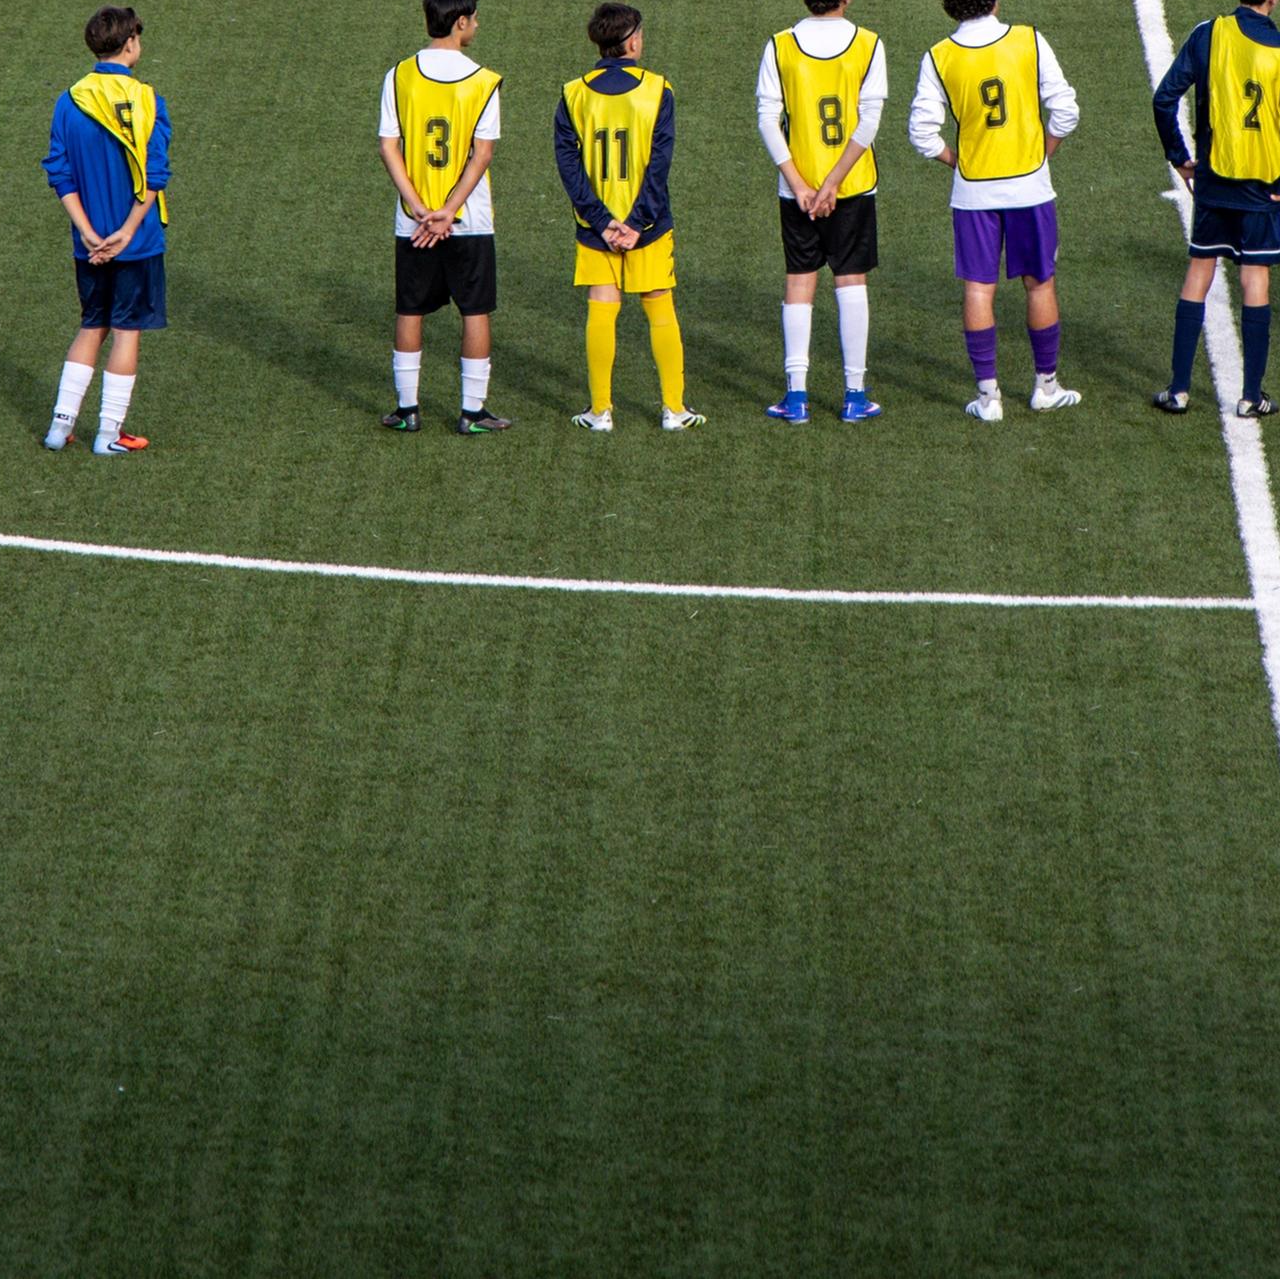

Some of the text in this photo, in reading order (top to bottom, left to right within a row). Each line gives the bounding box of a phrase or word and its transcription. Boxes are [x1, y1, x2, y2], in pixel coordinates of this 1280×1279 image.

[818, 95, 844, 146] 8
[978, 76, 1007, 127] 9
[1243, 79, 1264, 131] 2
[425, 118, 451, 168] 3
[592, 128, 629, 181] 11
